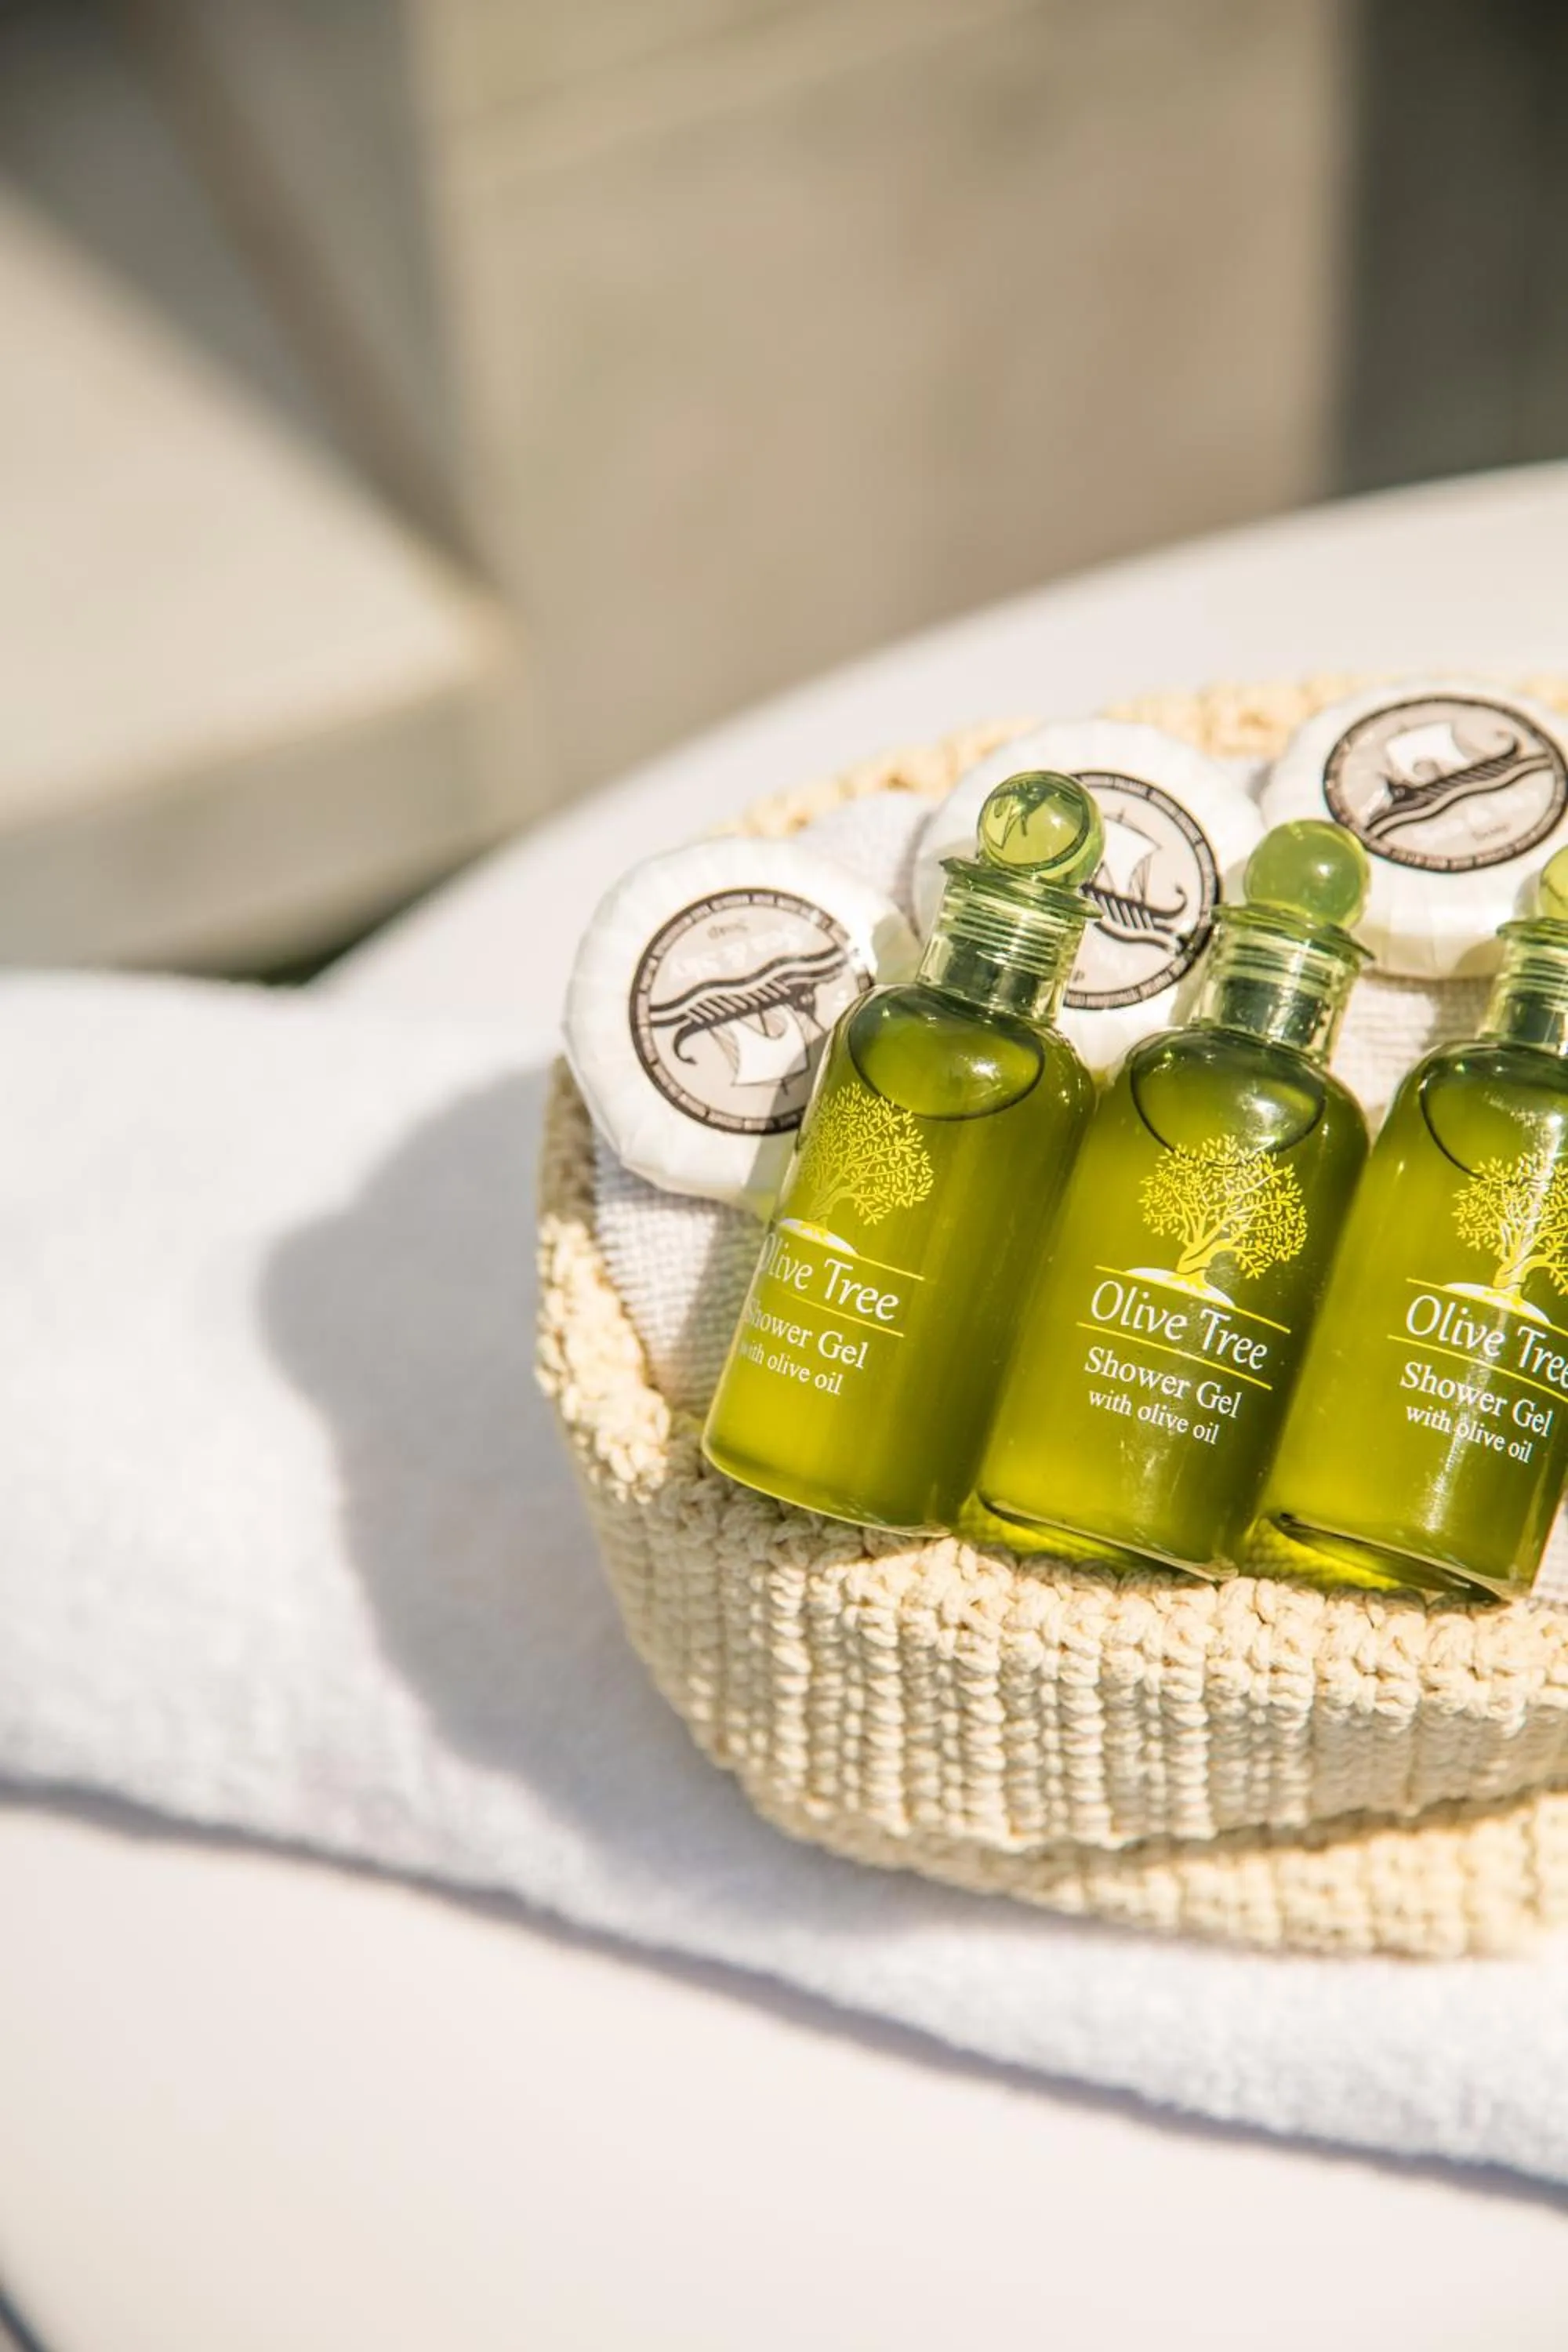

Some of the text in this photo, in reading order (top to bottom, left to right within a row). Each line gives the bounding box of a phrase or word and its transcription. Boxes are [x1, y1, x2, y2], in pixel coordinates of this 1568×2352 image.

[824, 1258, 900, 1320] Tree
[818, 1330, 869, 1370] Gel
[1091, 1280, 1268, 1370] Olive Tree
[1406, 1294, 1505, 1357] Olive
[768, 1352, 810, 1382] olive
[815, 1372, 843, 1396] oil
[1084, 1346, 1242, 1418] Shower Gel
[1399, 1361, 1553, 1437] Shower Gel
[1088, 1389, 1219, 1445] with olive oil
[1406, 1405, 1534, 1463] with olive oil
